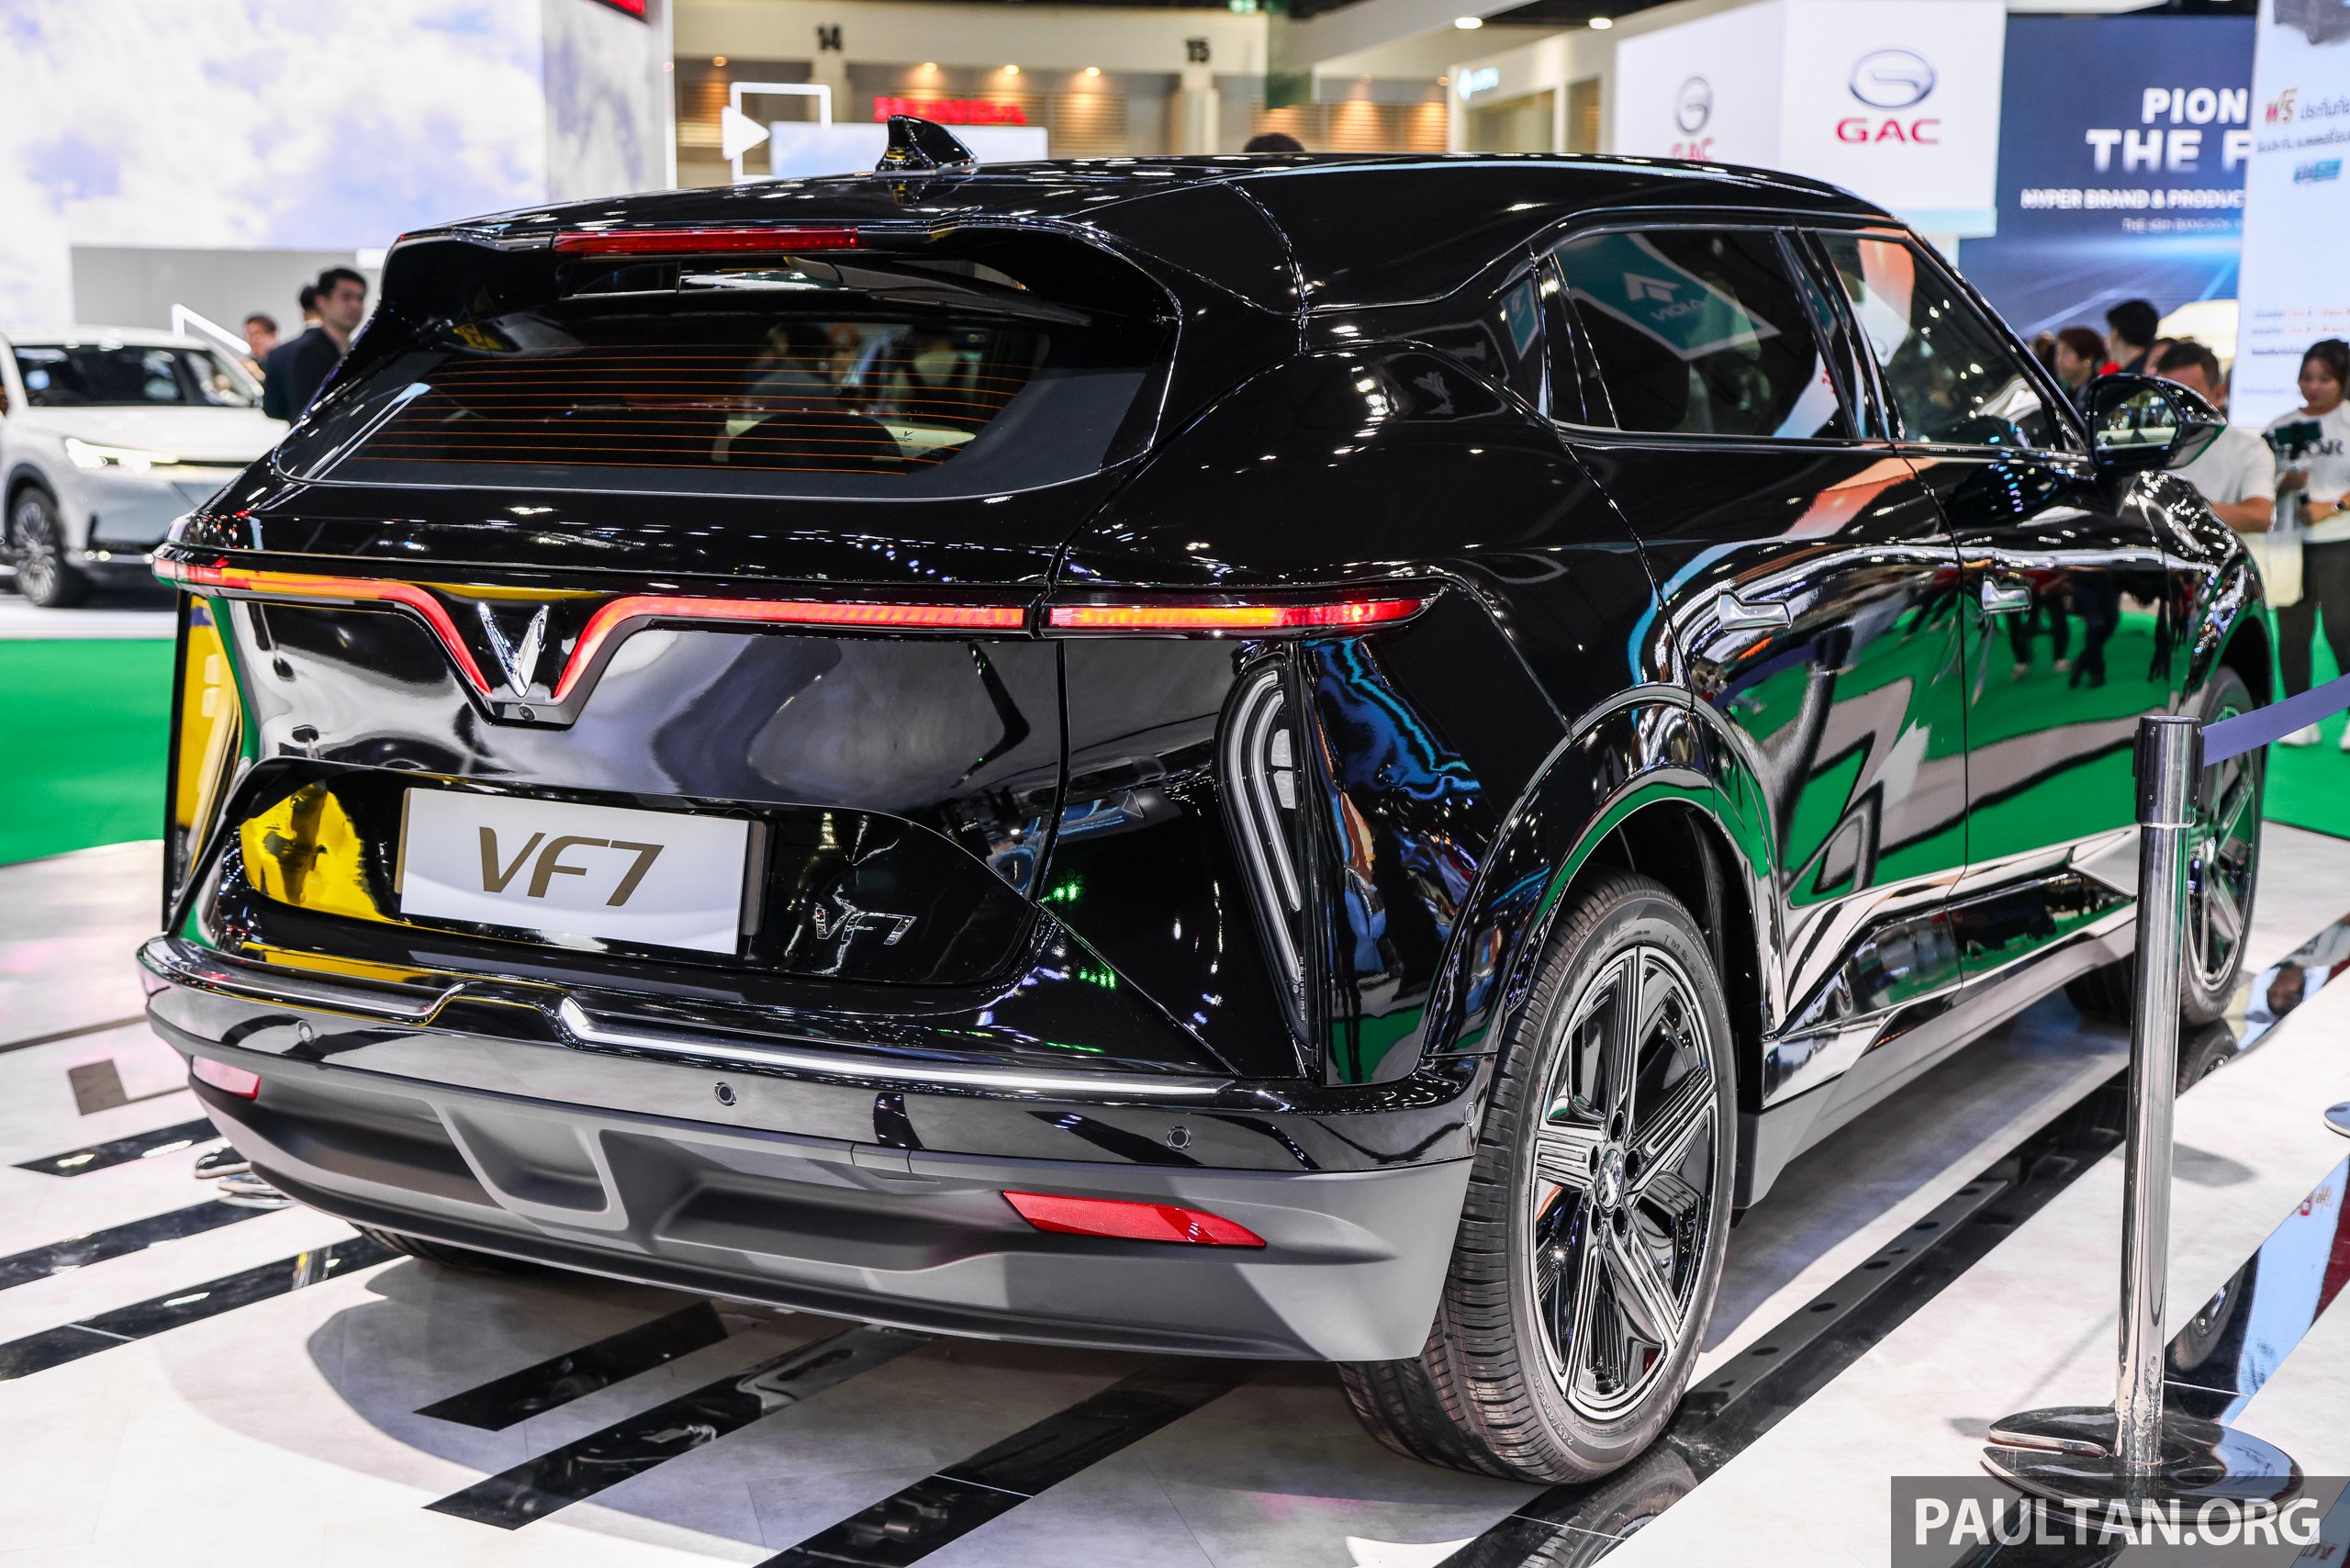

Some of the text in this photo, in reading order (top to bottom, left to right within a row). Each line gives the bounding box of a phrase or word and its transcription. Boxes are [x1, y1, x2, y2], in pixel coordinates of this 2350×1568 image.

[1186, 39, 1211, 63] 15
[2141, 87, 2249, 124] PION
[1836, 118, 1941, 144] GAC
[2085, 129, 2203, 174] THE
[2084, 188, 2150, 209] BRAND
[479, 825, 665, 907] VF7
[815, 907, 917, 946] VF7
